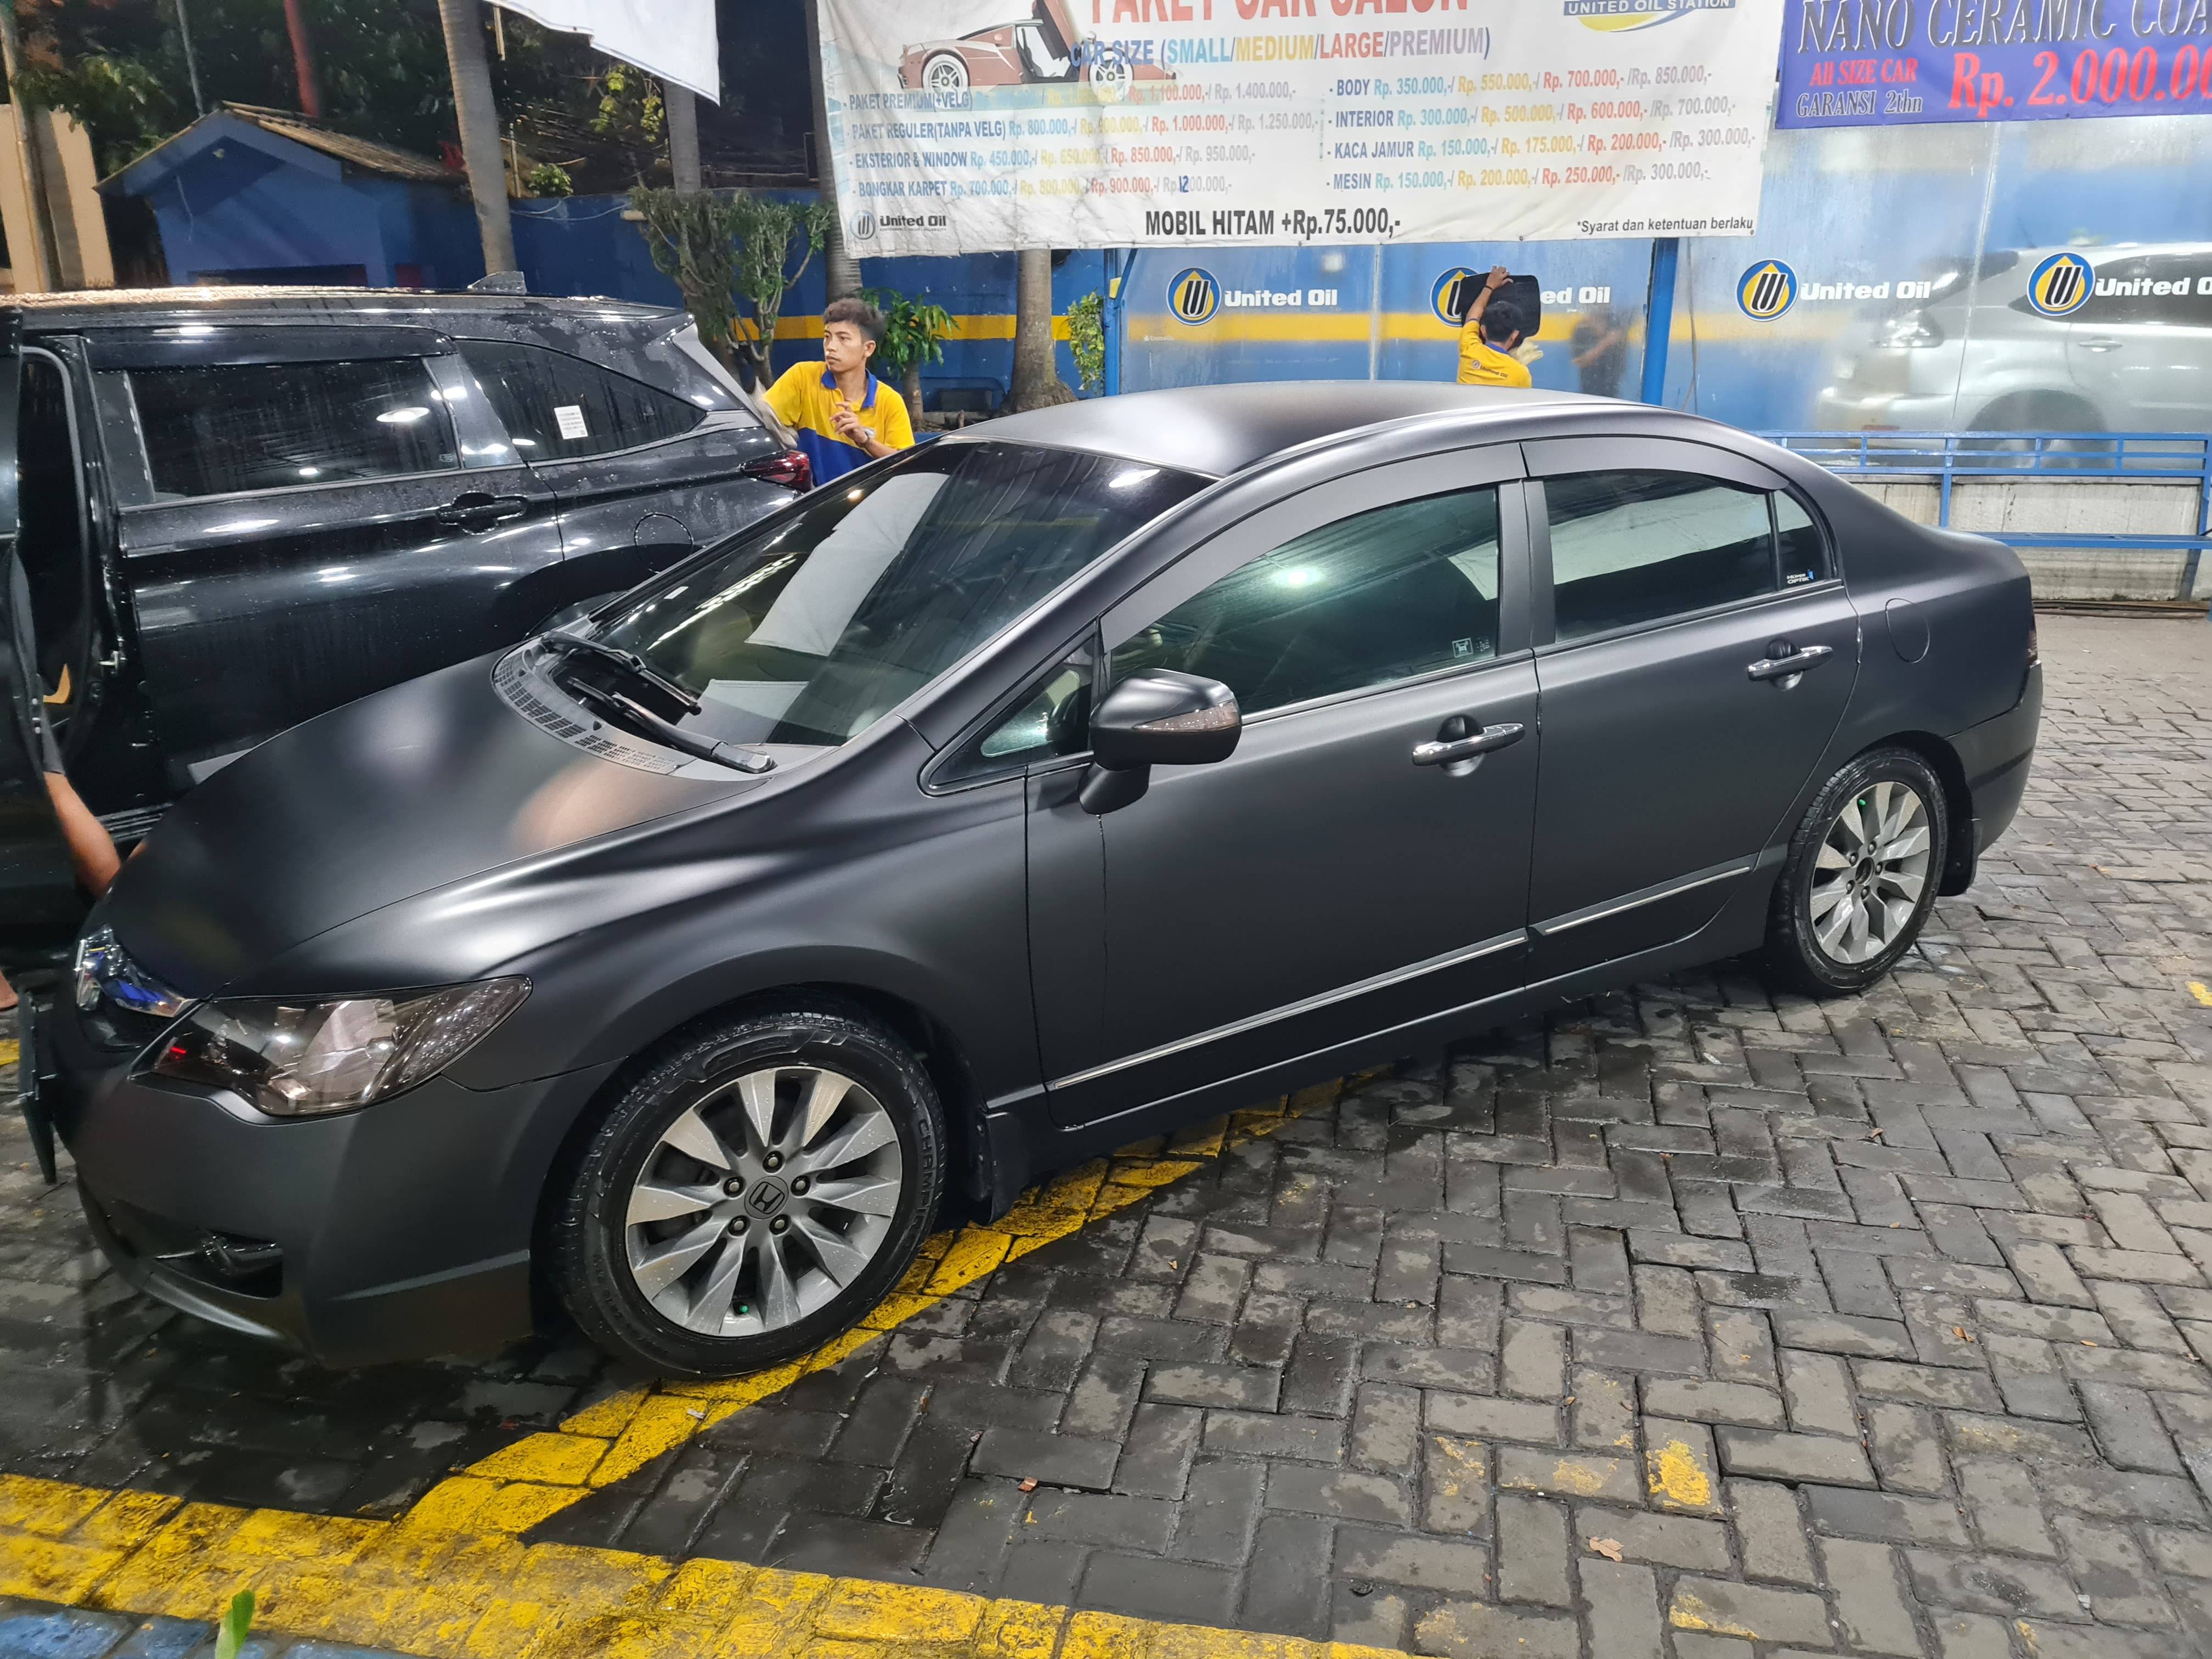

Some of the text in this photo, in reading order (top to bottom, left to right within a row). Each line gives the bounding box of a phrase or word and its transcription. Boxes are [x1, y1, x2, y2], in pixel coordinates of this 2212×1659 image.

[1567, 1, 1629, 14] UNITED
[1634, 0, 1663, 12] OIL
[1798, 0, 1916, 53] NANO
[1927, 0, 2117, 48] CERAMIC
[1070, 40, 1106, 67] CAR
[1111, 40, 1154, 65] SIZE
[1337, 79, 1370, 96] BODY
[1374, 79, 1392, 99] Rp.
[1458, 76, 1476, 96] Rp.
[1543, 72, 1562, 92] Rp.
[1567, 69, 1624, 89] 700.000,-
[1809, 58, 1918, 86] All SIZE CAR
[1215, 83, 1232, 103] Rp.
[1948, 52, 2014, 119] Rp.
[849, 93, 880, 110] PAKET
[1796, 88, 1922, 117] GARANSI 2thn
[1336, 110, 1393, 127] INTERIOR
[1397, 110, 1415, 130] Rp.
[1482, 106, 1500, 127] Rp.
[1567, 103, 1587, 123] Rp.
[1591, 100, 1647, 121] 600.000,-
[852, 123, 884, 139] PAKET
[887, 121, 970, 142] REGULER(TANPA
[975, 120, 1005, 140] VELG)
[1009, 121, 1024, 139] Rp.
[1152, 116, 1169, 136] Rp.
[1238, 115, 1255, 133] Rp.
[855, 151, 910, 168] EKSTERIOR
[913, 152, 918, 167] &
[922, 151, 967, 167] WINDOW
[970, 151, 986, 170] Rp.
[1111, 148, 1127, 167] Rp.
[1186, 146, 1202, 165] Rp.
[1335, 142, 1368, 159] KACA
[1372, 141, 1414, 158] JAMUR
[1418, 140, 1436, 161] Rp.
[1502, 137, 1520, 157] Rp.
[1588, 134, 1606, 155] Rp.
[1611, 132, 1667, 151] 200.000,-
[859, 181, 905, 197] BONGKAR
[909, 180, 947, 196] KARPET
[950, 180, 966, 201] Rp.
[1091, 177, 1106, 197] Rp.
[1334, 173, 1371, 190] MESIN
[1375, 172, 1393, 192] Rp.
[1458, 170, 1476, 190] Rp.
[1542, 168, 1561, 188] Rp.
[1565, 166, 1620, 185] 250.000,-
[879, 215, 946, 226] United Oil
[1146, 210, 1206, 235] MOBIL
[1212, 210, 1274, 235] HITAM
[1622, 218, 1644, 232] dan
[1648, 218, 1707, 230] ketentuan
[1711, 216, 1753, 229] berlaku
[1224, 290, 1302, 307] United
[1308, 289, 1338, 306] Oil
[1578, 286, 1611, 303] Oil
[1800, 282, 1890, 300] United
[1897, 281, 1931, 299] Oil
[2095, 277, 2191, 296] United
